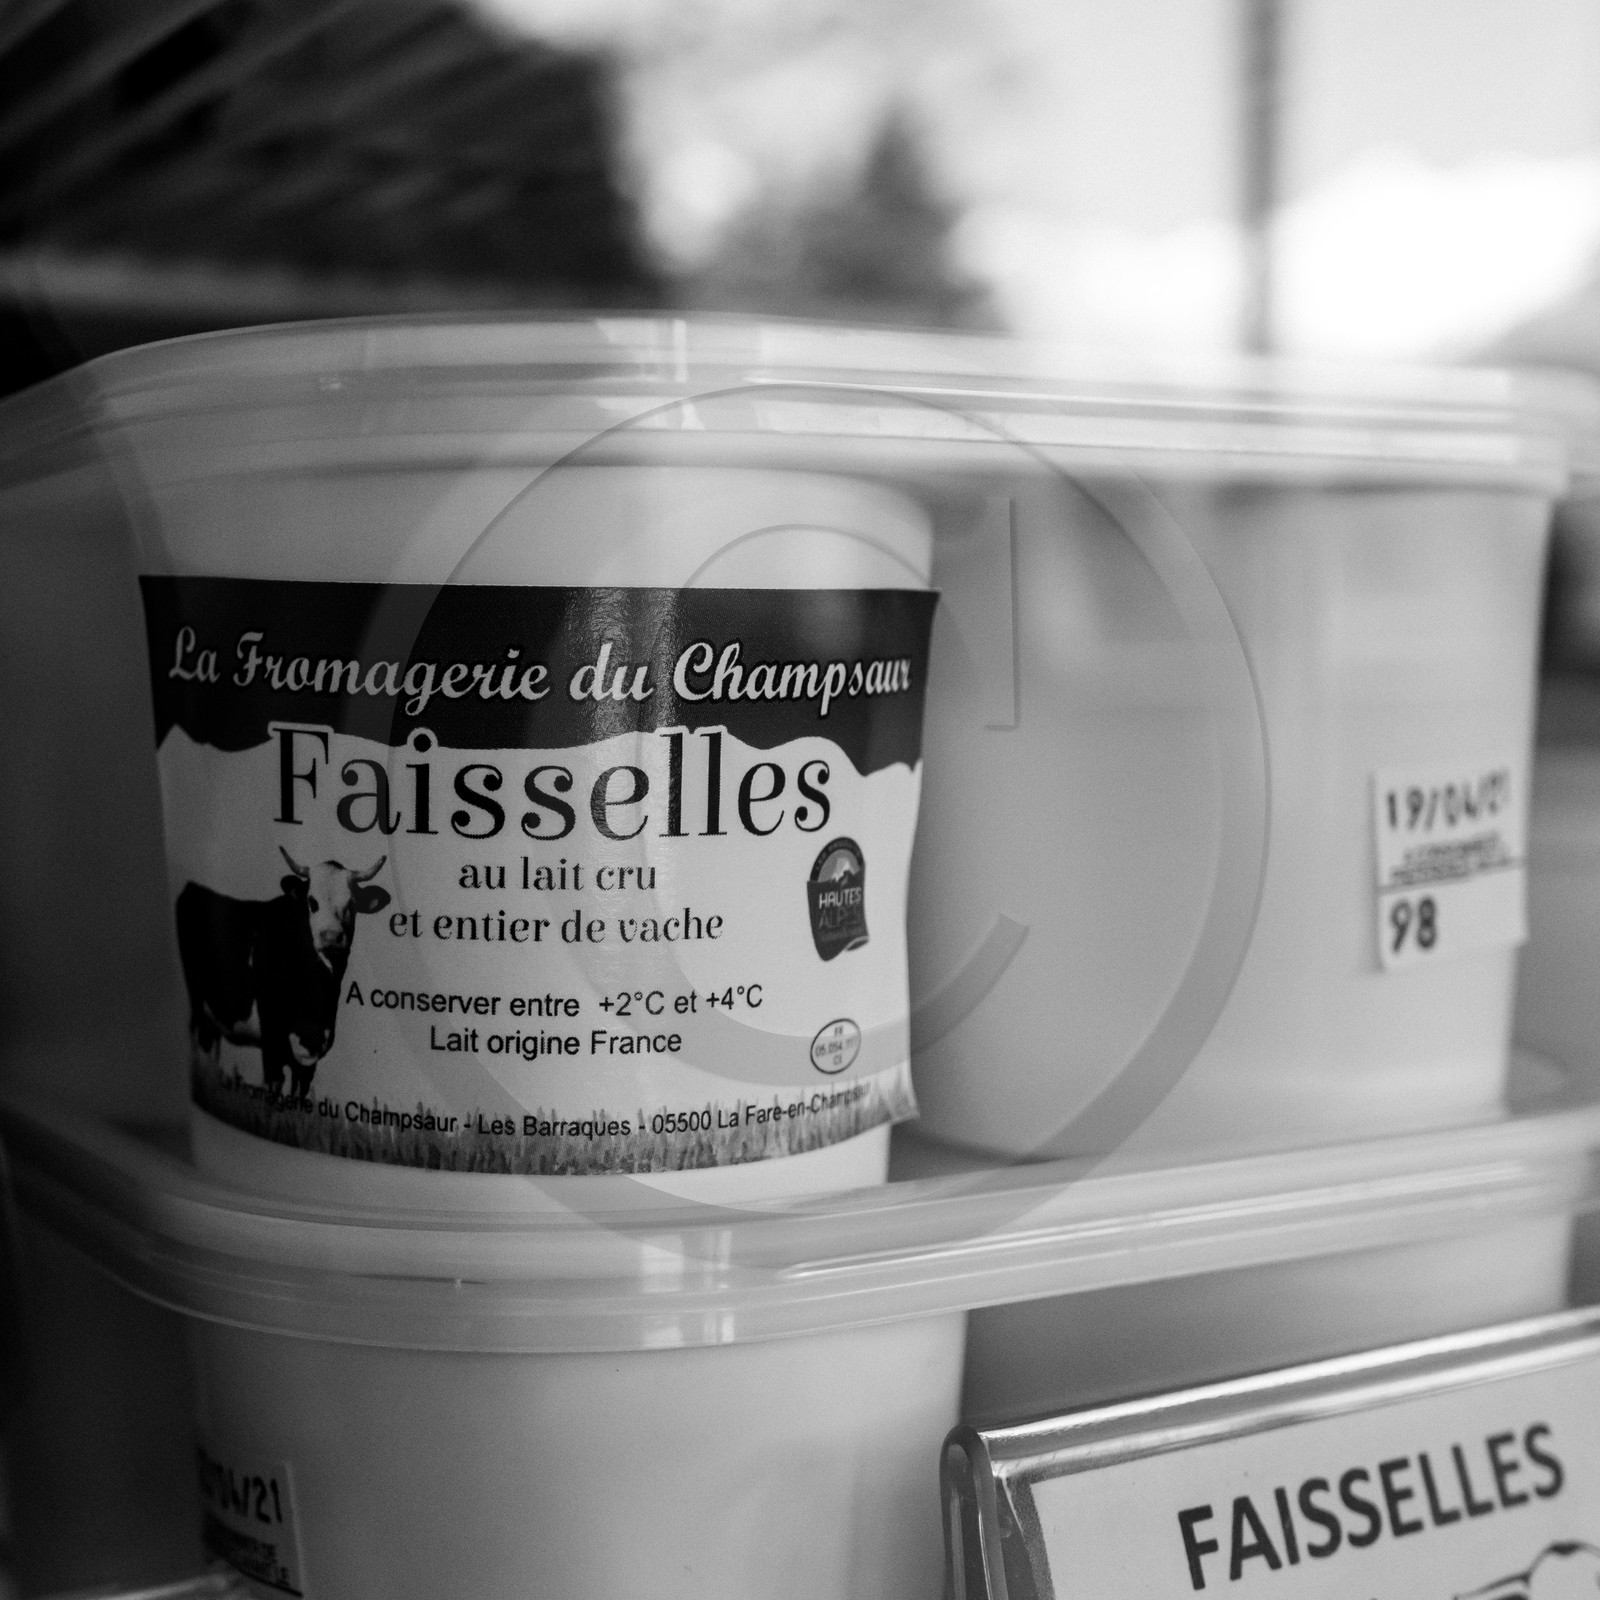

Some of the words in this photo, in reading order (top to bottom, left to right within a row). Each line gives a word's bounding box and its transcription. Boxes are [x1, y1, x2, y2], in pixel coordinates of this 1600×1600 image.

[169, 626, 220, 682] La
[233, 631, 551, 716] Fromagerie
[569, 643, 654, 701] du
[673, 642, 912, 716] Champsaur
[271, 727, 831, 841] Faisselles
[459, 863, 506, 890] au
[521, 857, 584, 891] lait
[596, 864, 657, 891] cru
[819, 888, 862, 909] HAUTES
[389, 909, 423, 938] et
[433, 910, 550, 943] entier
[561, 909, 605, 943] de
[618, 907, 724, 943] vache
[1390, 896, 1437, 953] 98
[346, 981, 364, 1006] A
[370, 988, 501, 1015] conserver
[510, 992, 580, 1017] entre
[599, 990, 664, 1016] +2°C
[674, 990, 697, 1014] et
[706, 984, 763, 1009] +4°C
[431, 1025, 478, 1053] Lait
[487, 1030, 580, 1061] origine
[591, 1030, 682, 1055] France
[318, 1097, 339, 1119] du
[345, 1101, 456, 1133] Champsaur
[478, 1114, 516, 1136] Les
[523, 1115, 631, 1140] Barraques
[652, 1110, 712, 1134] 05500
[718, 1109, 739, 1129] La
[1177, 1423, 1564, 1591] FAISSELLES
